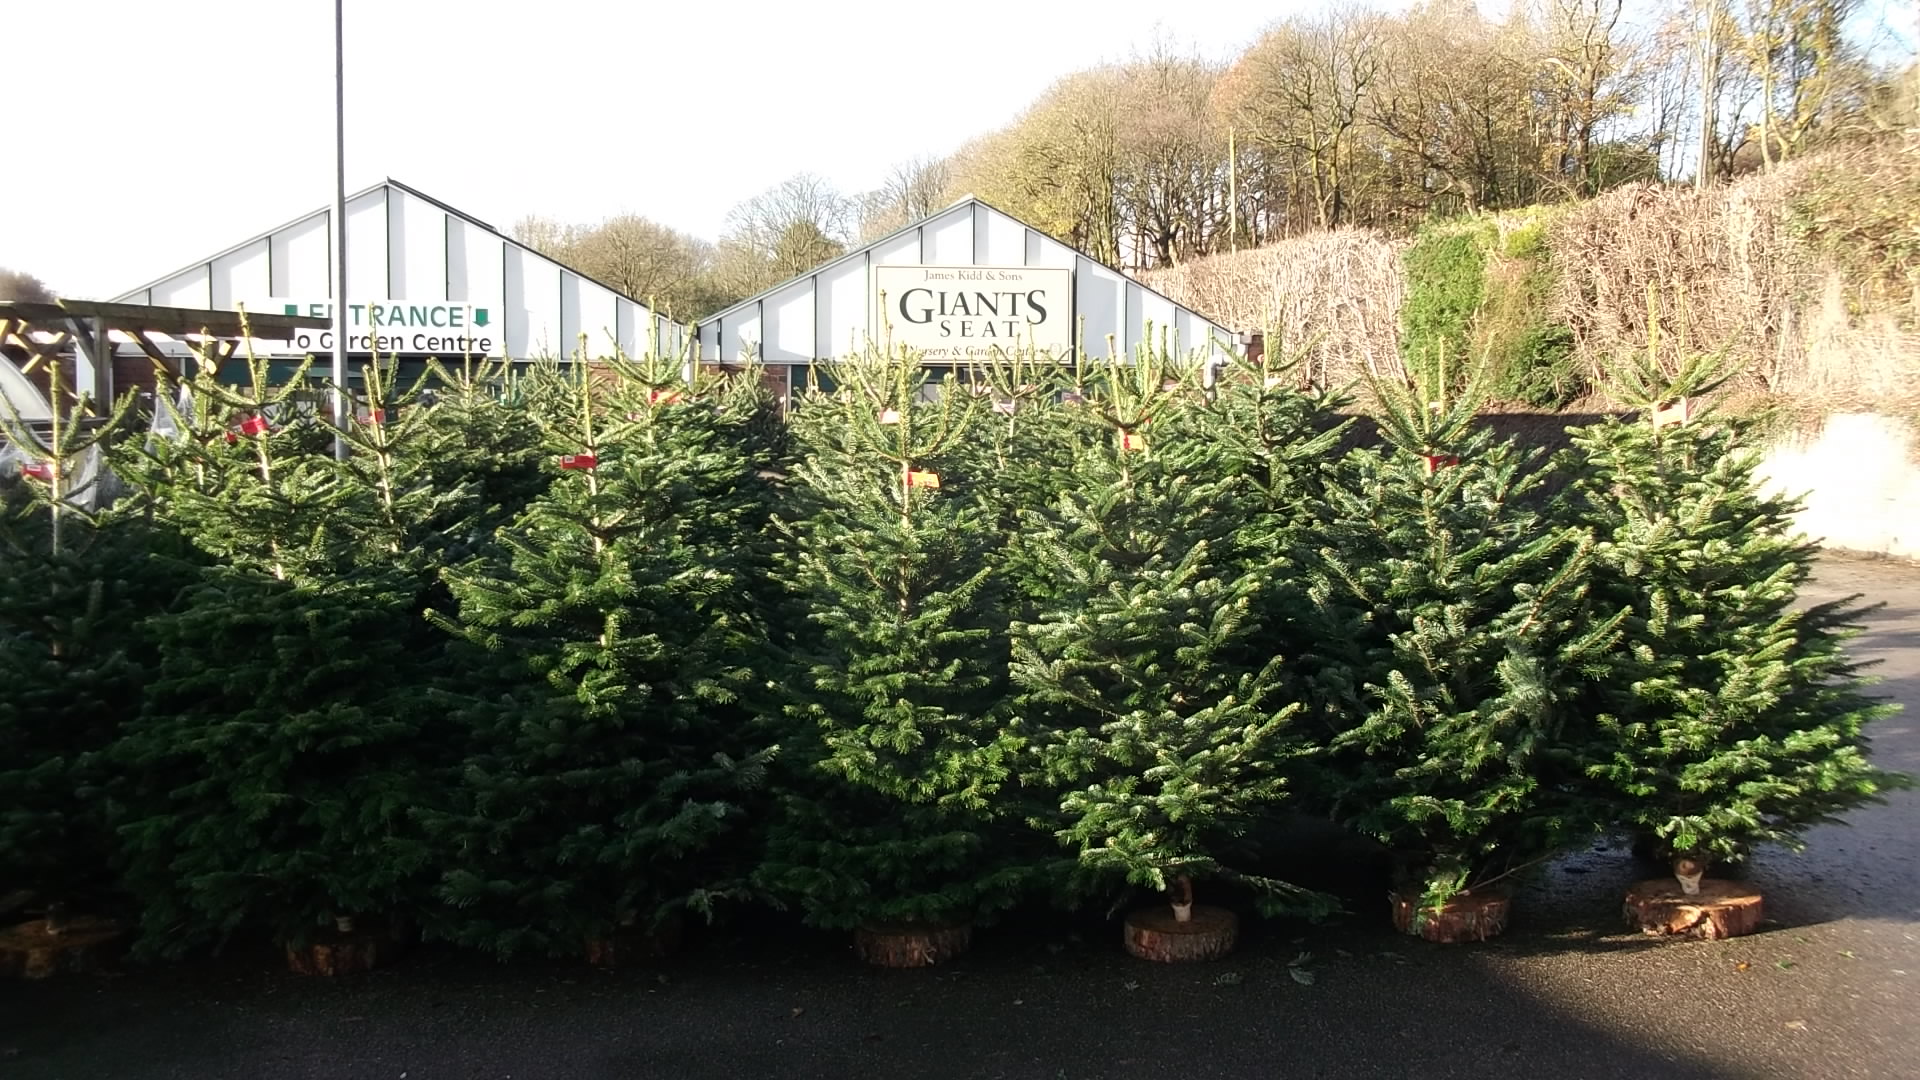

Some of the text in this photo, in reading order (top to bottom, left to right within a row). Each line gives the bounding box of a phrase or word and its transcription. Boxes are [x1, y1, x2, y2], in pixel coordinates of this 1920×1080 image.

[924, 270, 1023, 281] James Kidd & Sons
[899, 288, 1047, 325] GIANTS
[310, 304, 463, 328] ETRANCE
[940, 320, 1019, 337] SEAT
[320, 332, 404, 350] Grden
[413, 333, 492, 352] Centre
[909, 345, 949, 359] Nrsery
[952, 345, 961, 356] &
